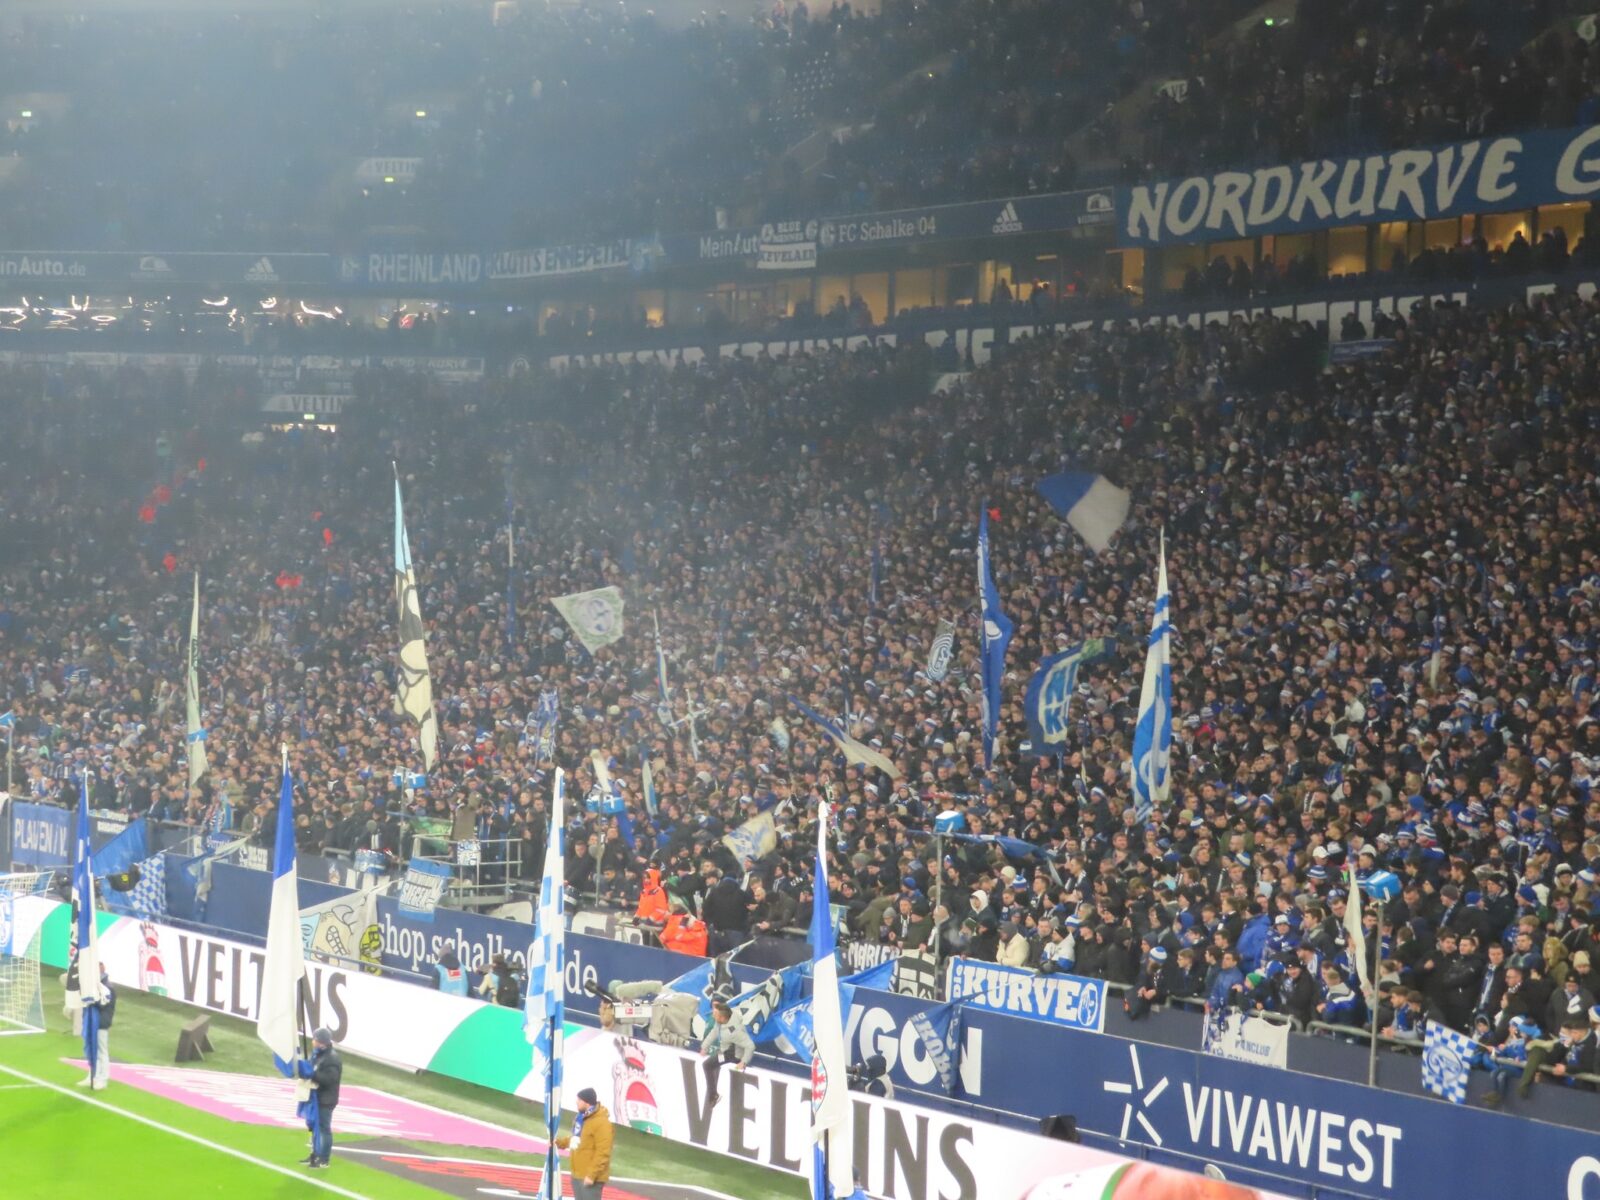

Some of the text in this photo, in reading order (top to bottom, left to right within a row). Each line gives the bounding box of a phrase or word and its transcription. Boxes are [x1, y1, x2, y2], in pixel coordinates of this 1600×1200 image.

[838, 215, 937, 243] FC Schalke 04
[1127, 137, 1523, 242] NORDKURVE
[368, 253, 481, 283] RHEINLAND
[179, 935, 348, 1043] VELTNS
[963, 965, 1082, 1022] KURVE
[680, 1057, 977, 1200] VELINS
[1183, 1082, 1402, 1189] VIVAWEST
